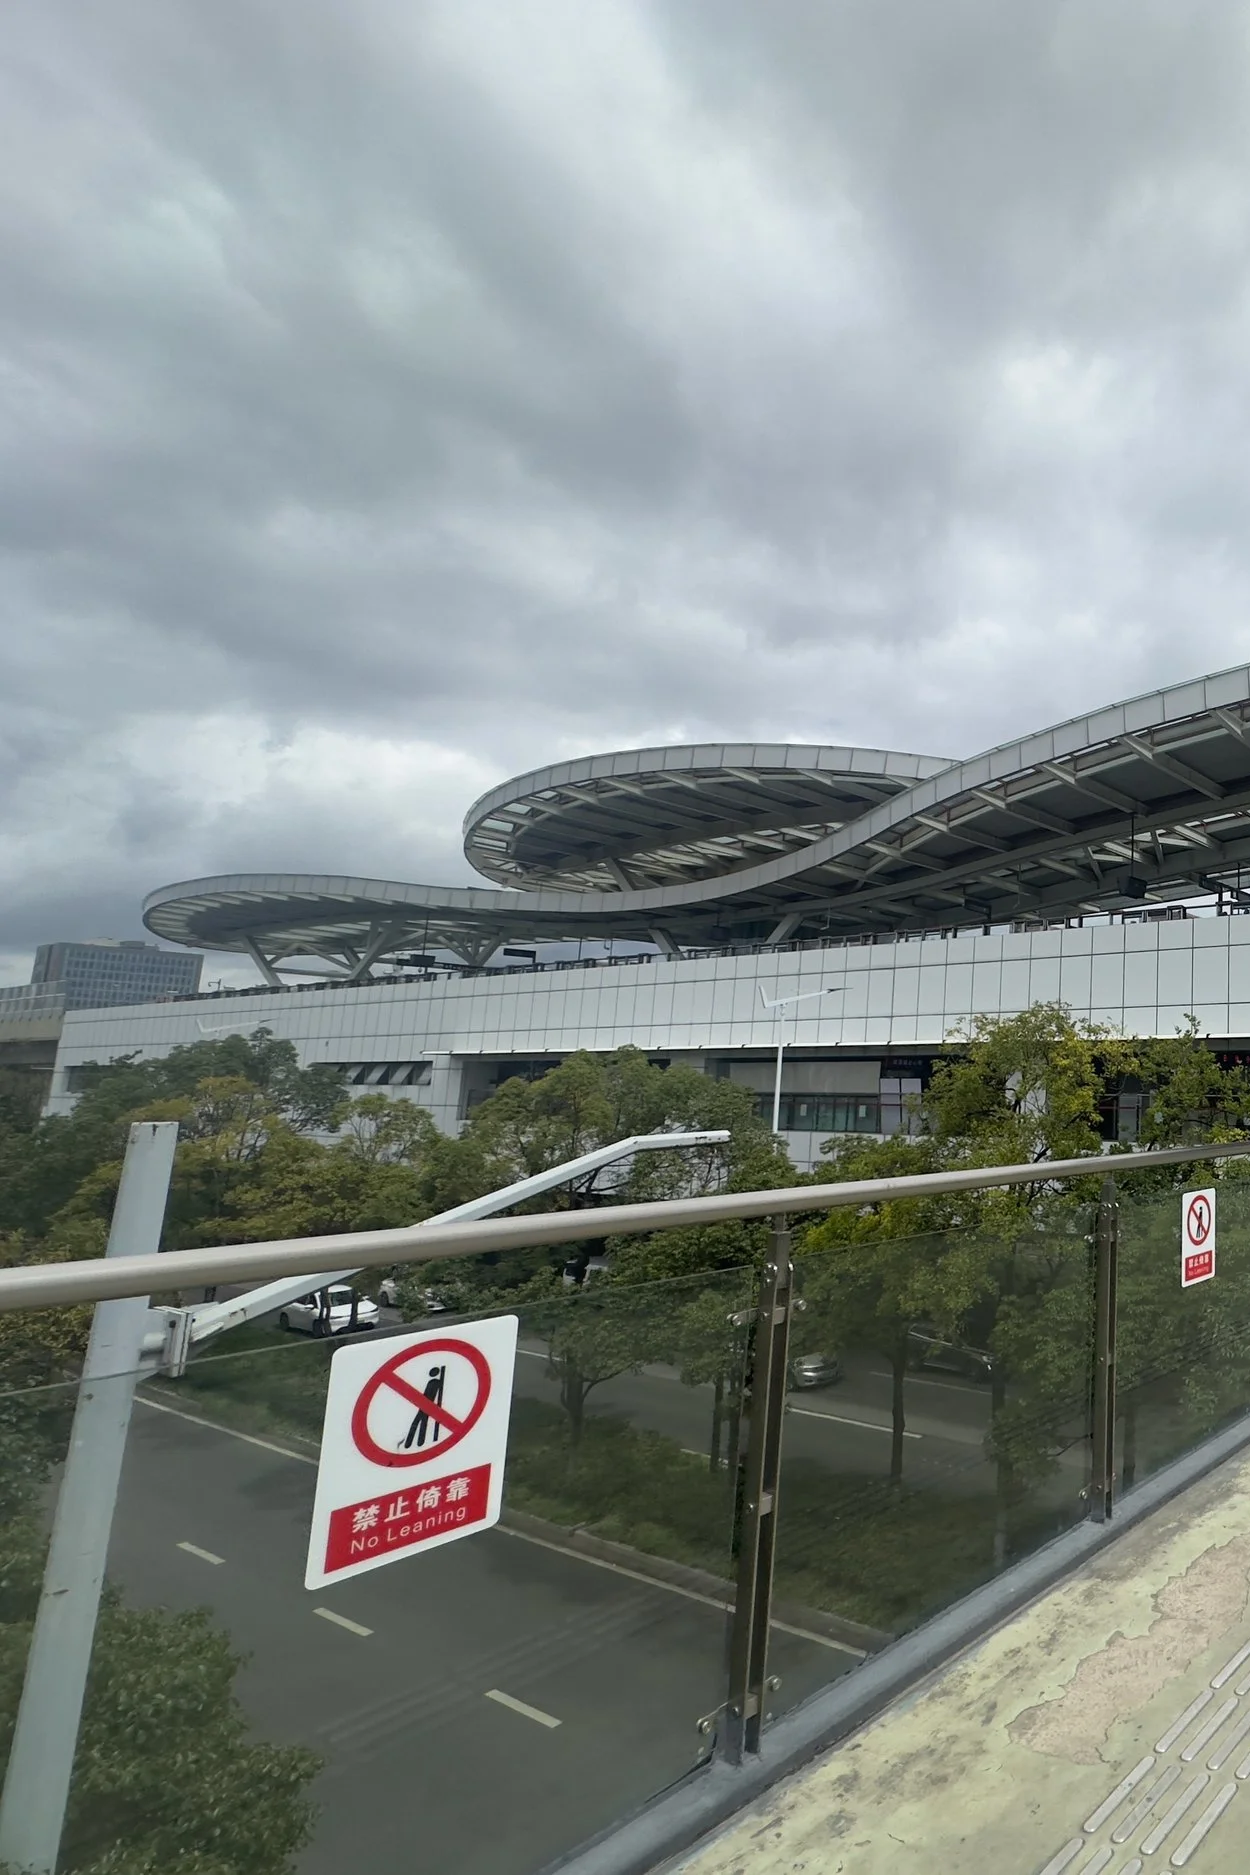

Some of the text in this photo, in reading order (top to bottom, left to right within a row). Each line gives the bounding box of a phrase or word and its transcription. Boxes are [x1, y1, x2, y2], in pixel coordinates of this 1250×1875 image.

[350, 1506, 466, 1555] No Leaning
[352, 1476, 471, 1534] 禁止倚靠
